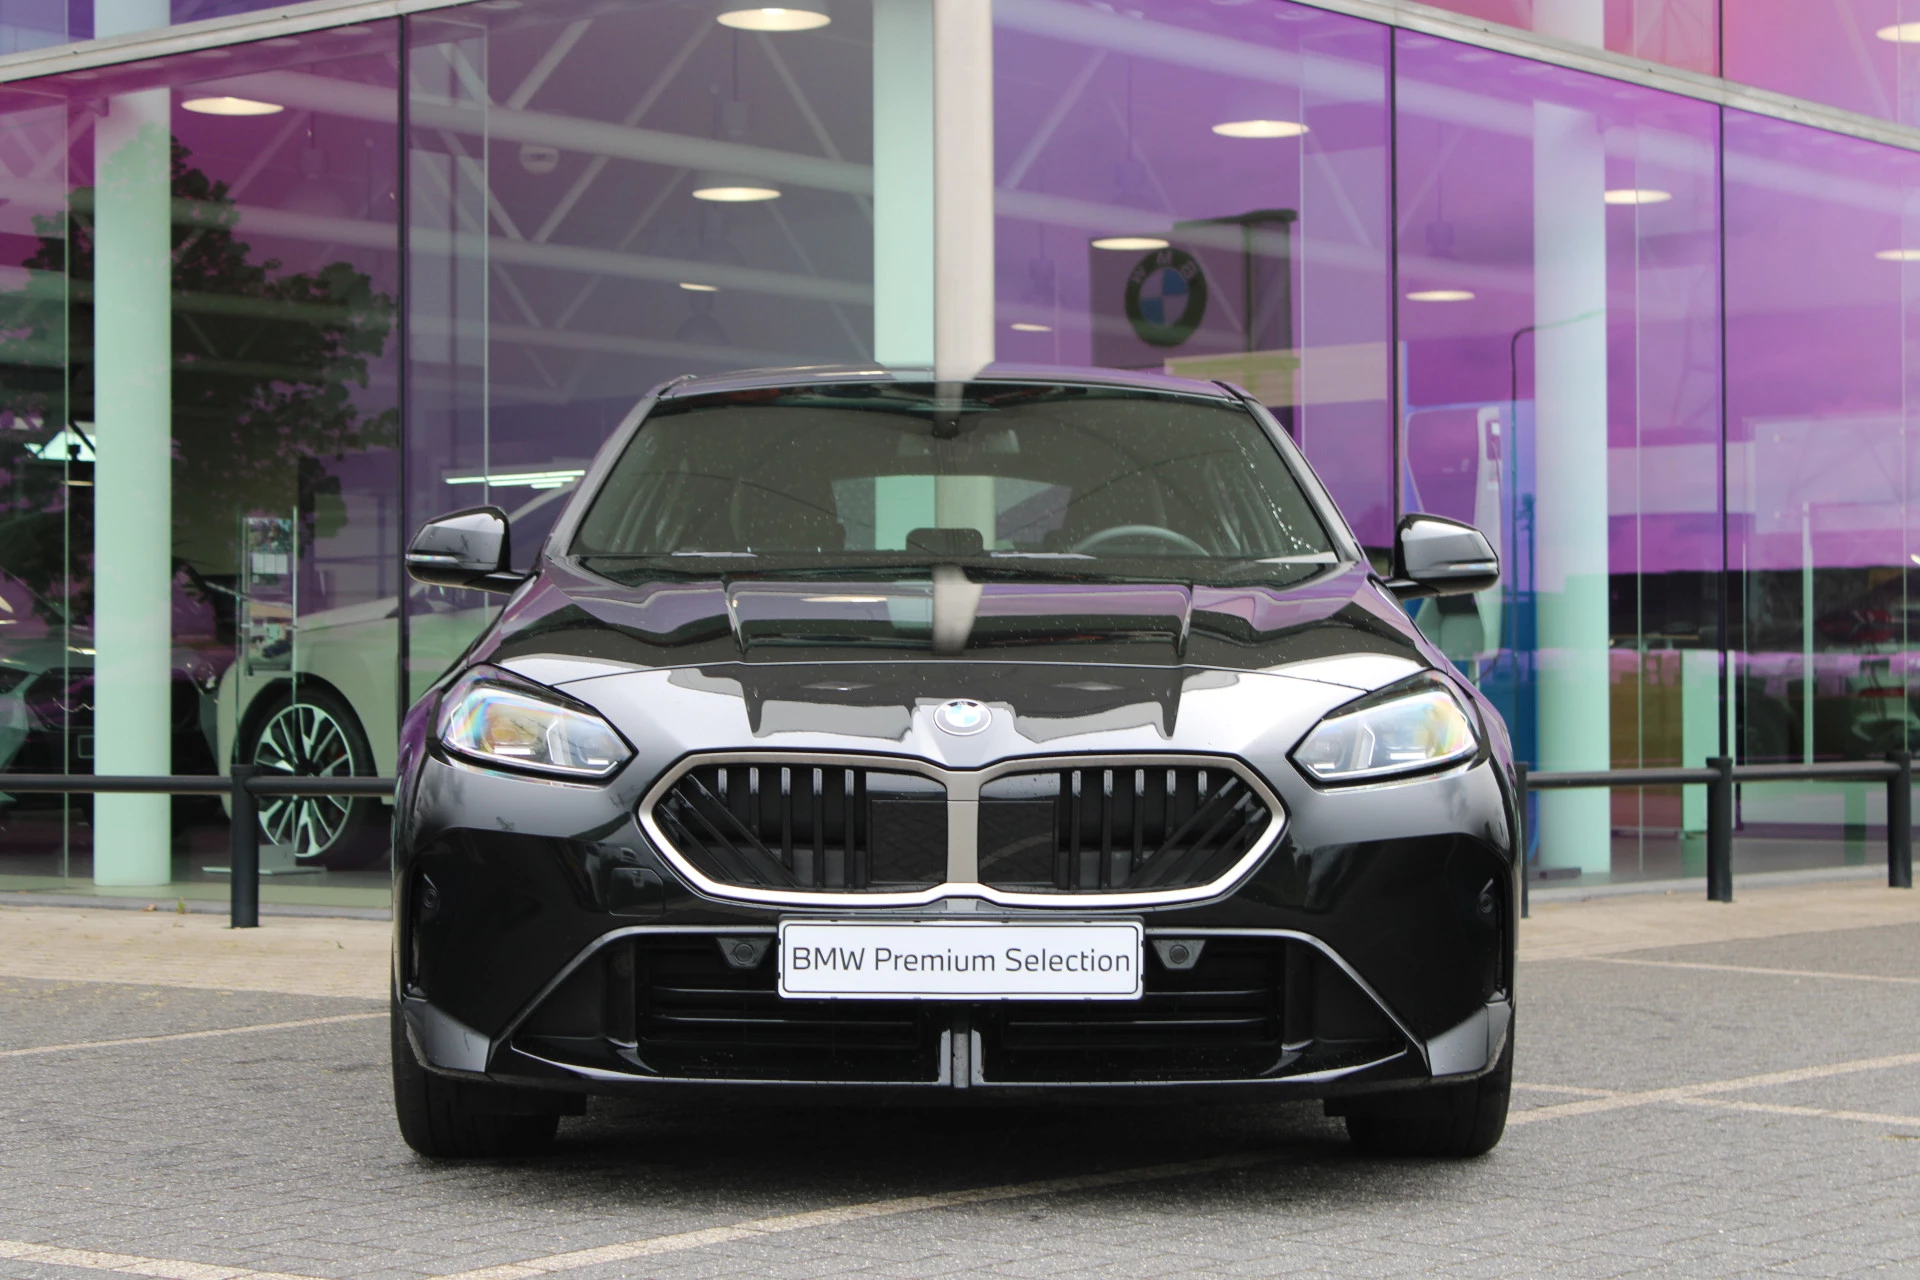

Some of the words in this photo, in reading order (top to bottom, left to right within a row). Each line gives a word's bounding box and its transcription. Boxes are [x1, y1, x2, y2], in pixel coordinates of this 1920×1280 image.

[792, 947, 865, 970] BMW
[875, 947, 995, 972] Premium
[1005, 948, 1131, 972] Selection
